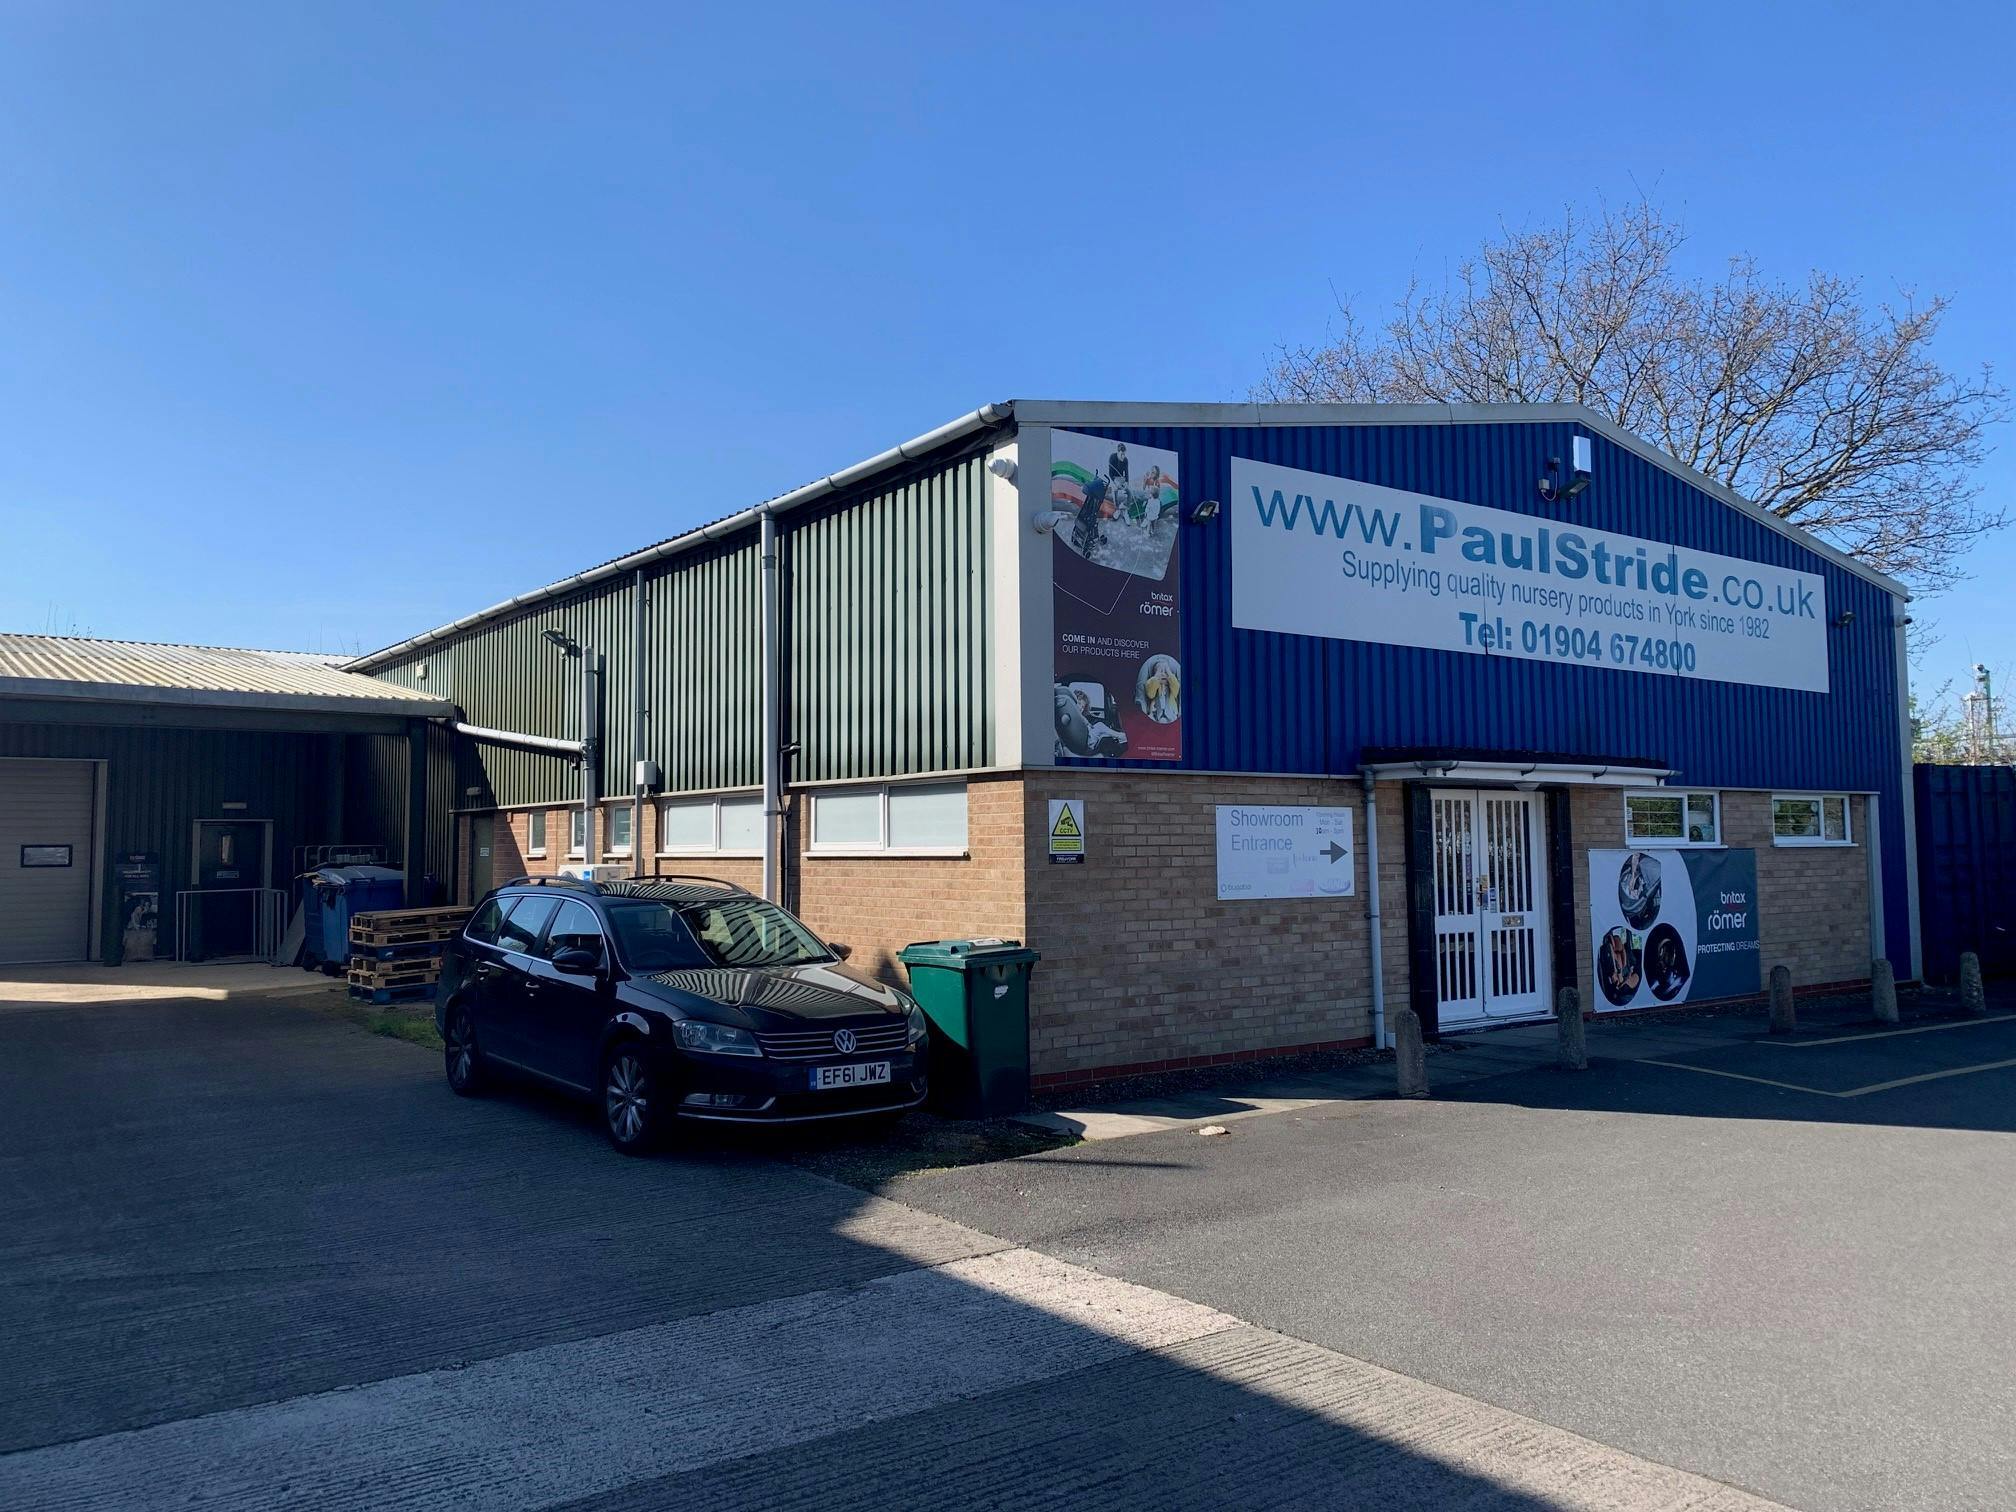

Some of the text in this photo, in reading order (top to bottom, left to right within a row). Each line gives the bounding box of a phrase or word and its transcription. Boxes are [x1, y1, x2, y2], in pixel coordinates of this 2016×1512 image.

[1250, 485, 1816, 620] www.PaulStride.co.uk
[1151, 591, 1173, 602] britax
[1342, 550, 1770, 639] Supplying quality nursery products in York since 1982
[1139, 601, 1174, 617] römer
[1062, 633, 1150, 650] COME IN AND DISCOVER
[1459, 611, 1696, 672] Tel: 01904 674800
[1062, 644, 1141, 660] OUR PRODUCTS HERE
[1230, 809, 1304, 827] Showroom
[1231, 834, 1293, 851] Entrance
[1720, 891, 1746, 904] britax
[1708, 910, 1747, 930] römer
[1697, 940, 1760, 954] PROTECTING DREAMS
[822, 1063, 886, 1086] EF61 JWZ
